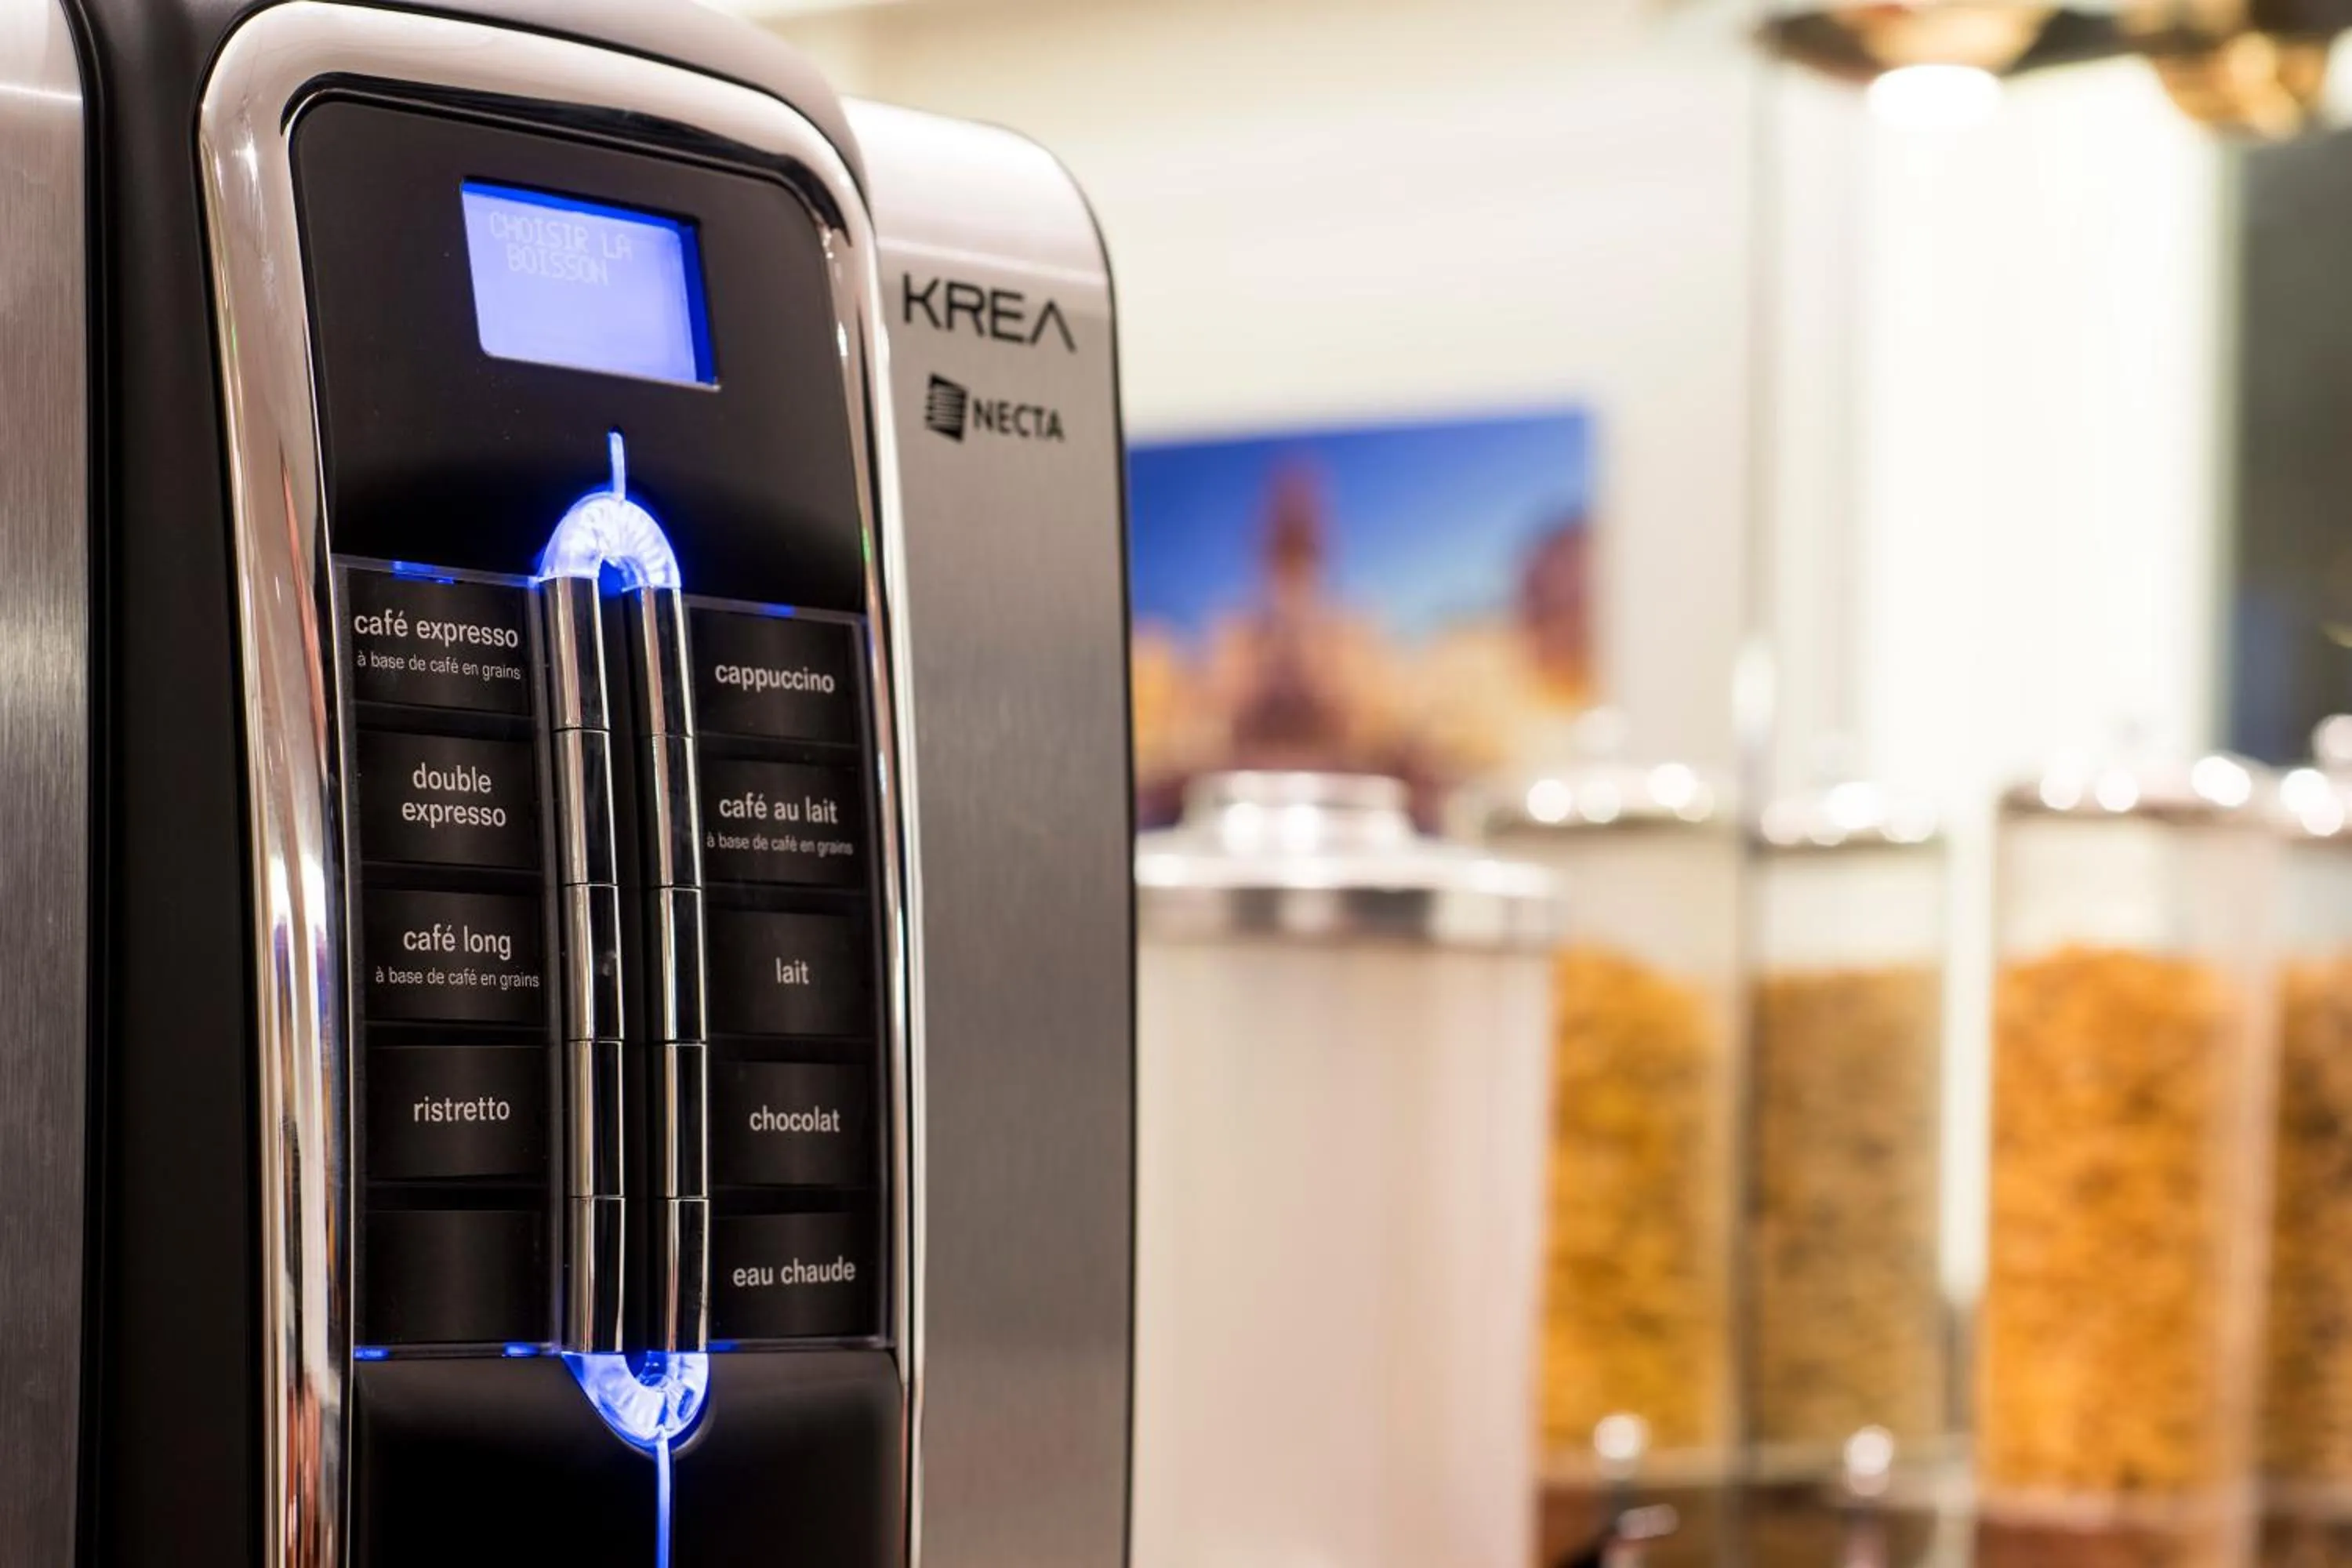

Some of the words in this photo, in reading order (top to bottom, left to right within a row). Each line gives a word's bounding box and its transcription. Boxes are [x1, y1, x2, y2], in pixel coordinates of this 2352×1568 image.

[506, 243, 608, 285] BOISSON
[902, 272, 1077, 354] KREA
[973, 397, 1065, 443] NECTA
[354, 608, 408, 637] café
[417, 619, 518, 648] expresso
[358, 650, 366, 666] à
[371, 652, 405, 670] base
[408, 655, 426, 671] de
[430, 656, 459, 674] café
[463, 661, 479, 676] en
[482, 663, 521, 681] grains
[715, 665, 835, 693] cappuccino
[413, 762, 492, 793] double
[402, 801, 506, 829] expresso
[719, 792, 767, 819] café
[774, 801, 799, 821] au
[805, 796, 838, 823] lait
[707, 832, 715, 848] à
[718, 833, 750, 849] base
[753, 833, 768, 851] de
[771, 834, 797, 851] café
[800, 840, 815, 852] en
[817, 840, 853, 857] grains
[403, 924, 456, 952] café
[463, 925, 511, 960] long
[376, 966, 384, 984] à
[388, 967, 423, 985] base
[427, 967, 445, 985] de
[448, 968, 477, 985] café
[481, 971, 496, 985] en
[499, 971, 540, 990] grains
[775, 957, 809, 985] lait
[413, 1096, 510, 1122] ristretto
[750, 1105, 840, 1133] chocolat
[732, 1267, 773, 1287] eau
[781, 1256, 856, 1284] chaude
